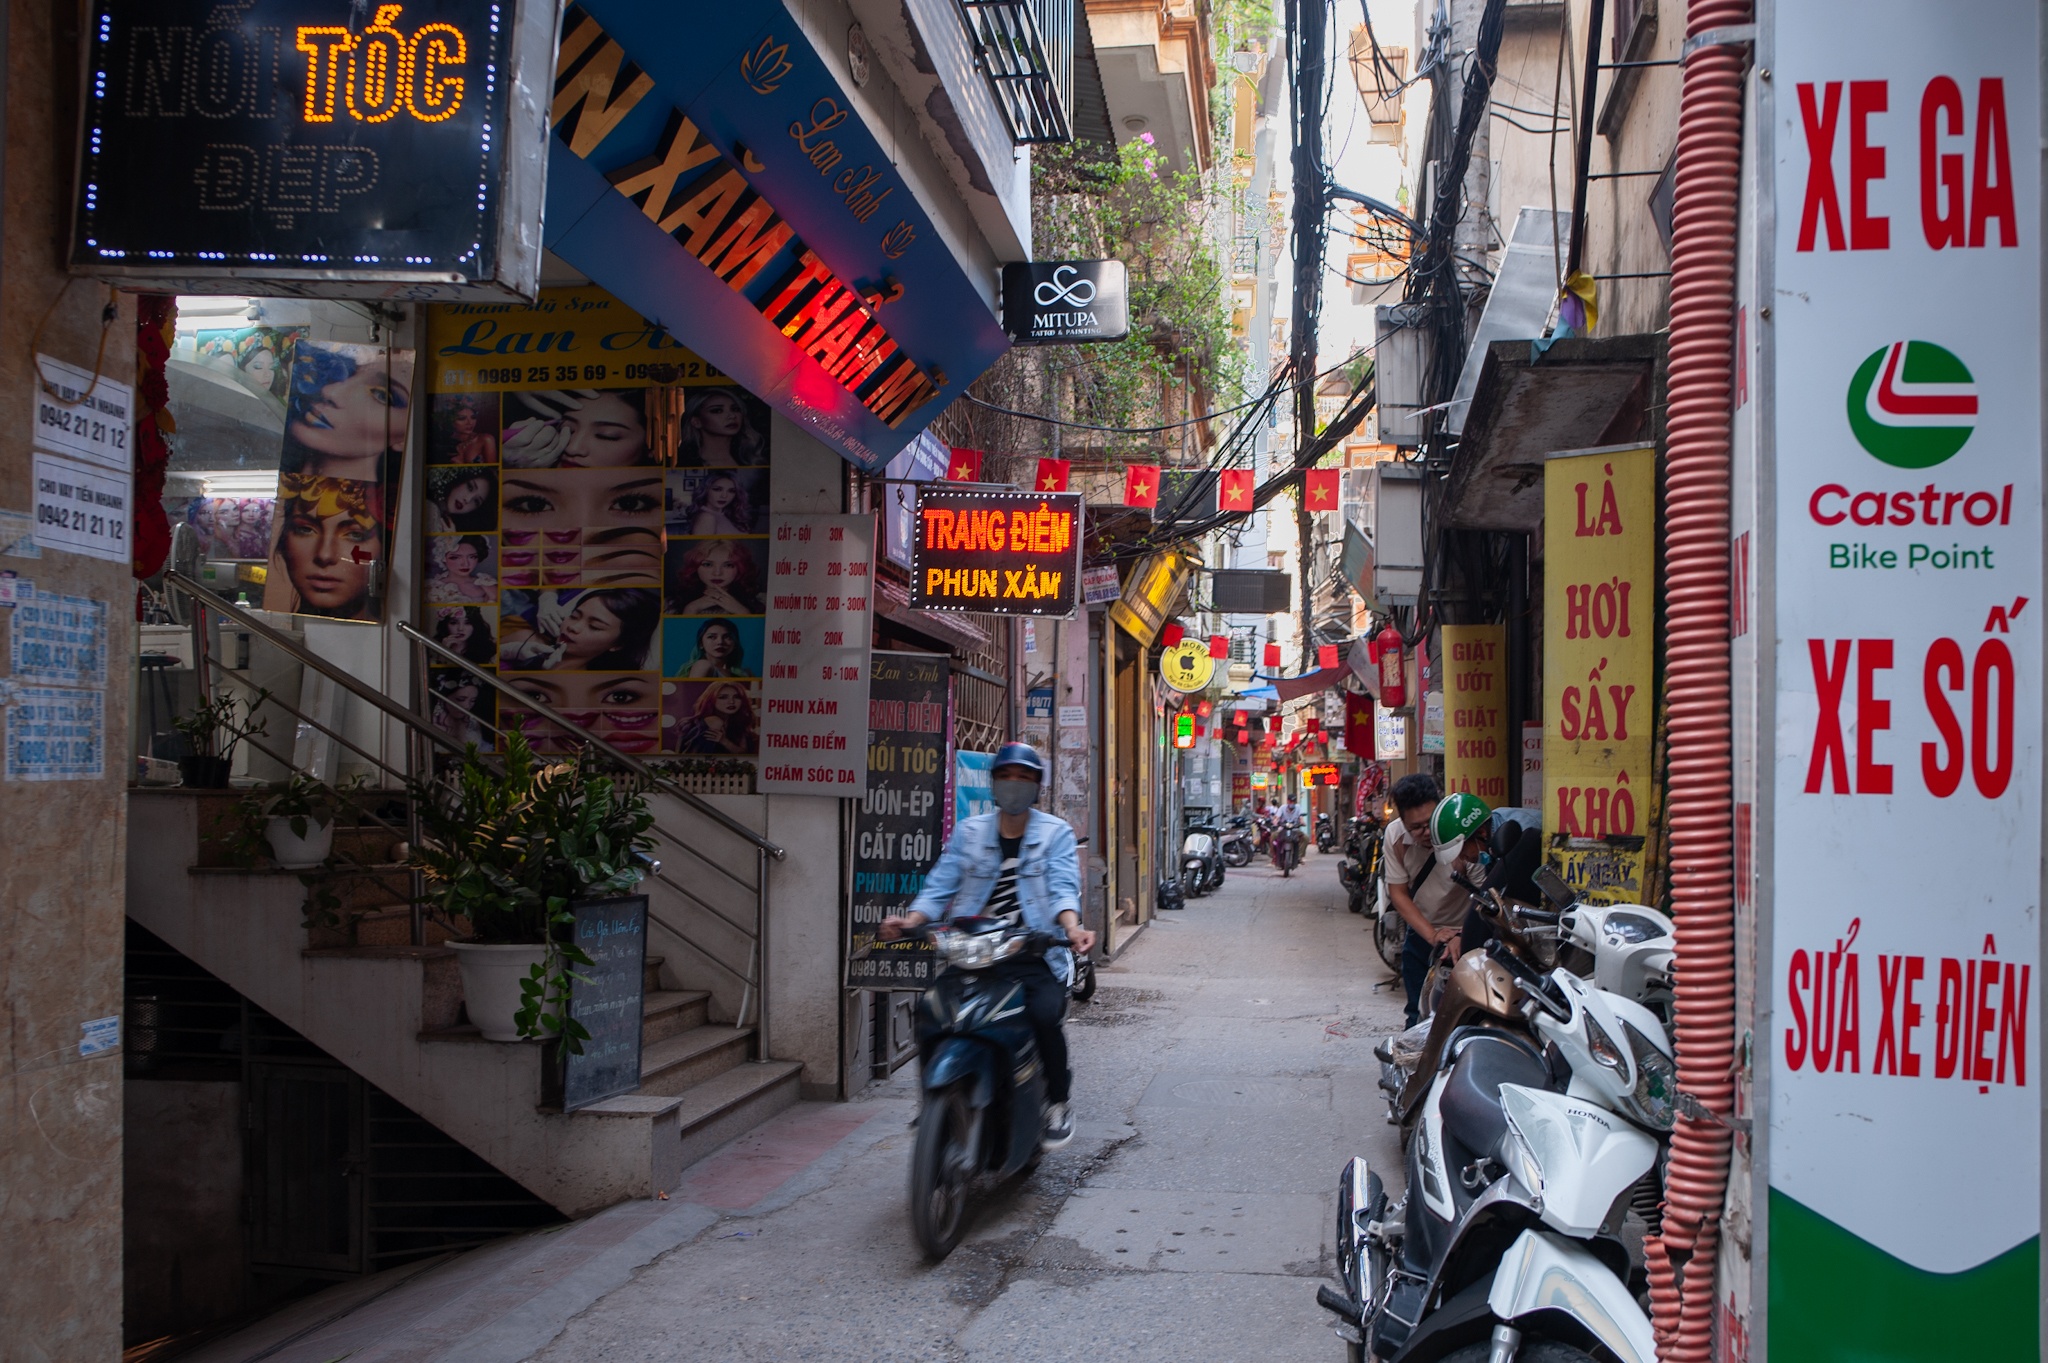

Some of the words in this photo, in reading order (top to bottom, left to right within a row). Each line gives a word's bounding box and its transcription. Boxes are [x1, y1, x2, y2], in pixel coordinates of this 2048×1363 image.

[297, 4, 467, 122] TÓC
[789, 96, 848, 177] Lan
[833, 163, 894, 225] Anh
[1796, 80, 1892, 252] XE
[1920, 75, 2019, 251] GA
[612, 113, 797, 294] XĂM
[760, 248, 907, 394] THẨM
[862, 356, 951, 431] MỸ
[564, 296, 611, 313] Spa
[1033, 311, 1099, 329] MITUPA
[1066, 328, 1101, 336] PAINTING
[440, 319, 581, 358] Lan
[477, 367, 522, 384] 0989
[527, 366, 551, 383] 25
[556, 365, 578, 382] 35
[583, 364, 606, 381] 69
[61, 384, 76, 402] VAY
[98, 399, 125, 420] NHANH
[39, 402, 70, 433] 0942
[73, 414, 89, 437] 21
[92, 419, 106, 444] 21
[111, 427, 125, 449] 12
[38, 477, 56, 495] CHO
[58, 481, 74, 499] VAY
[95, 492, 123, 510] NHANH
[1574, 463, 1623, 537] LÀ
[1808, 483, 2014, 527] Castrol
[38, 503, 69, 529] 0942
[72, 510, 86, 532] 21
[90, 515, 104, 536] 21
[109, 519, 123, 540] 12
[923, 509, 1006, 551] TRANG
[1009, 502, 1071, 552] ĐIỂM
[777, 526, 792, 542] CẮT
[798, 527, 811, 543] GỘI
[829, 527, 844, 541] 30K
[775, 555, 791, 576] UỐN
[798, 560, 808, 576] ÉP
[827, 562, 842, 576] 200
[848, 562, 868, 577] 300K
[1829, 542, 1898, 569] Bike
[1908, 542, 1995, 570] Point
[926, 568, 998, 598] PHUN
[1003, 564, 1062, 600] XĂM
[773, 595, 801, 613] NHUỘM
[802, 593, 817, 611] TÓC
[825, 597, 841, 611] 200
[847, 597, 866, 611] 300K
[1565, 576, 1631, 640] HƠI
[771, 626, 785, 645] NỐI
[786, 628, 801, 645] TÓC
[824, 631, 843, 646] 200K
[1452, 639, 1497, 664] GIẶT
[769, 661, 786, 679] UỐN
[787, 665, 797, 679] MI
[822, 666, 833, 681] 50
[840, 666, 859, 681] 100K
[869, 660, 900, 680] Lan
[907, 665, 939, 683] Anh
[1180, 671, 1194, 680] 79
[1456, 668, 1493, 692] ƯỚT
[768, 699, 803, 714] PHUN
[807, 697, 838, 715] XĂM
[1560, 658, 1636, 741] SẤY
[1803, 638, 1895, 796] XE
[1921, 596, 2030, 800] SỐ
[868, 698, 905, 731] RANG
[907, 690, 942, 733] ĐIỂM
[1454, 705, 1498, 731] GIẶT
[766, 733, 808, 749] TRANG
[812, 729, 847, 751] ĐIỂM
[1457, 736, 1497, 758] KHÔ
[901, 742, 938, 774] TÓC
[764, 764, 803, 783] CHĂM
[807, 764, 834, 783] SÓC
[838, 769, 856, 784] DA
[1451, 774, 1472, 794] LÀ
[1477, 775, 1504, 797] HƠI
[1556, 770, 1636, 838] KHÔ
[1460, 807, 1483, 829] Grab
[859, 824, 896, 861] CẮT
[900, 829, 932, 868] GỘI
[855, 872, 896, 894] PHUN
[854, 899, 883, 924] UỐN
[851, 960, 876, 977] 0989
[914, 961, 928, 978] 69
[1785, 917, 1862, 1075] SỬA
[1873, 954, 1925, 1078] XE
[1934, 933, 2031, 1095] ĐIỆN
[1567, 1109, 1611, 1131] HONDA
